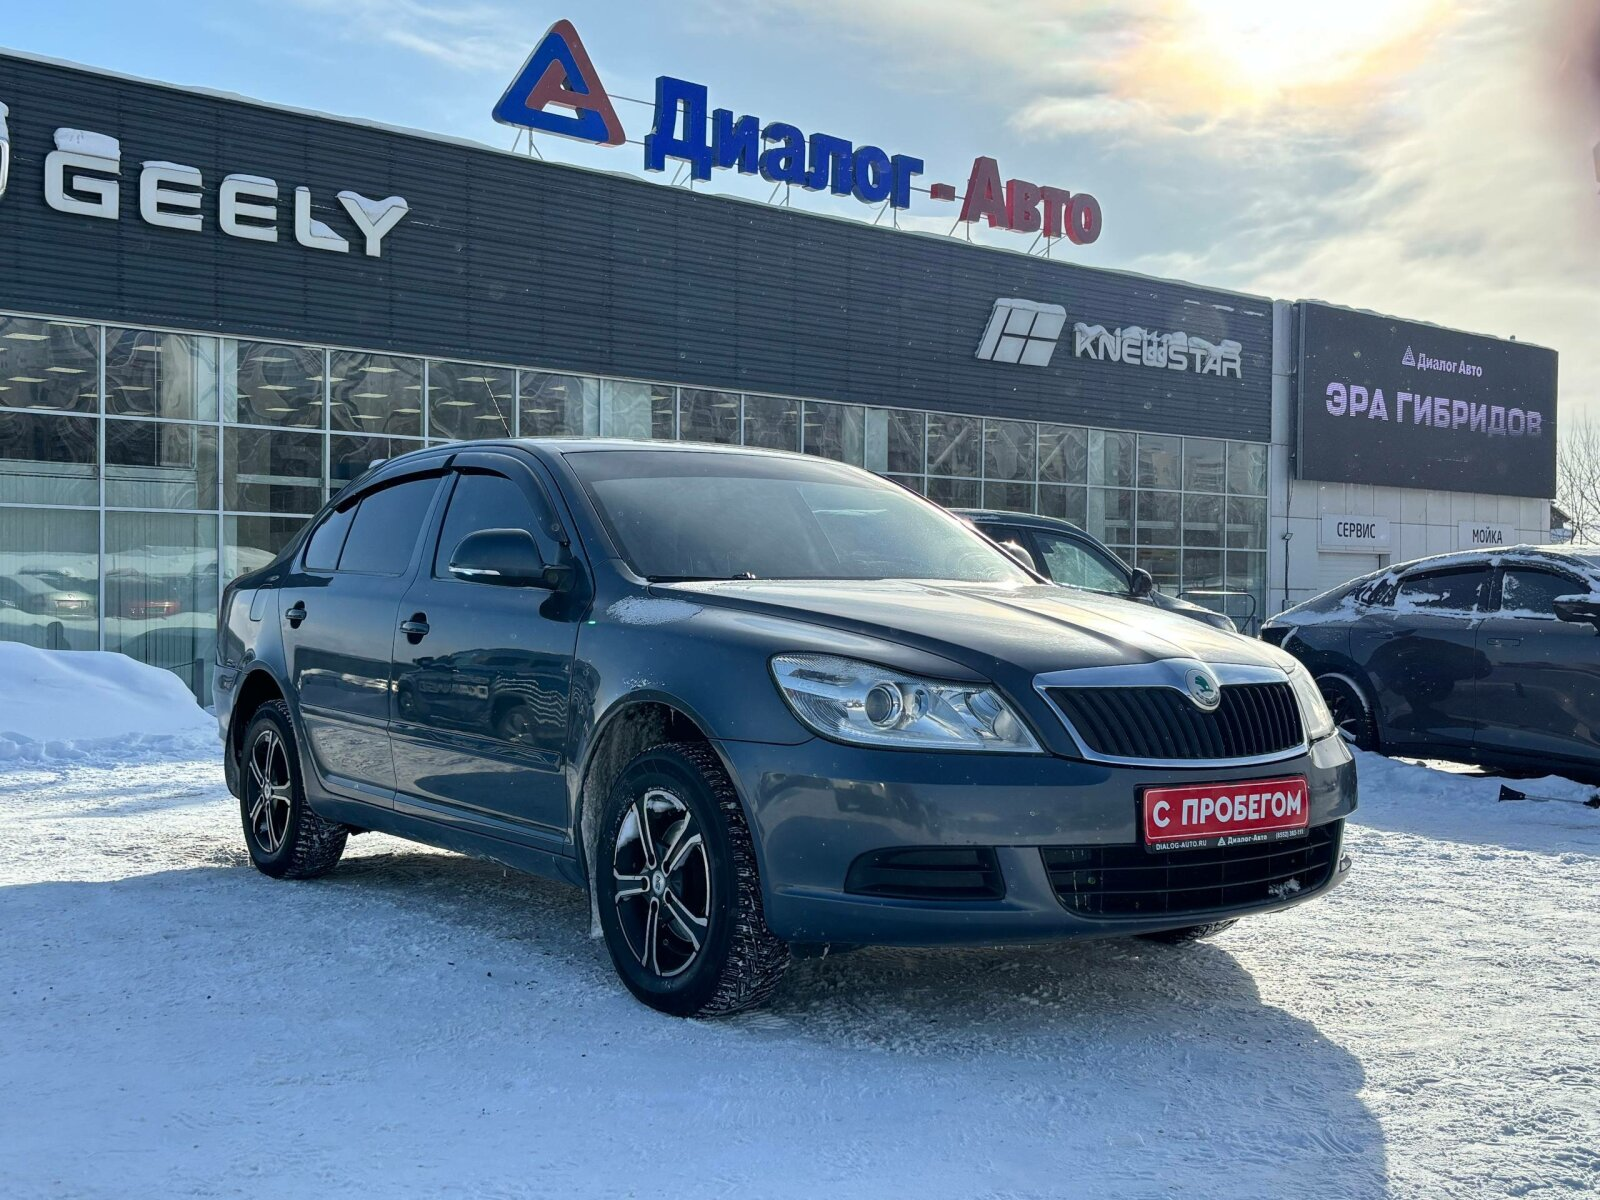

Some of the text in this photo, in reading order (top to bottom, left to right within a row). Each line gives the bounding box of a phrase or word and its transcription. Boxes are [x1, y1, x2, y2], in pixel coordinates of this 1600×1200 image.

[44, 144, 409, 258] GEELY
[1417, 353, 1483, 377] Диалог Авто
[1326, 382, 1542, 437] ЭРА ГИБРИДОВ
[1336, 521, 1376, 539] СЕРВИС
[1472, 526, 1503, 544] МОЙКА
[1153, 790, 1301, 828] С ПРОБЕГОМ
[1155, 840, 1207, 850] DIALOG-AUTO.RU
[1227, 834, 1268, 845] Диалог-Авто
